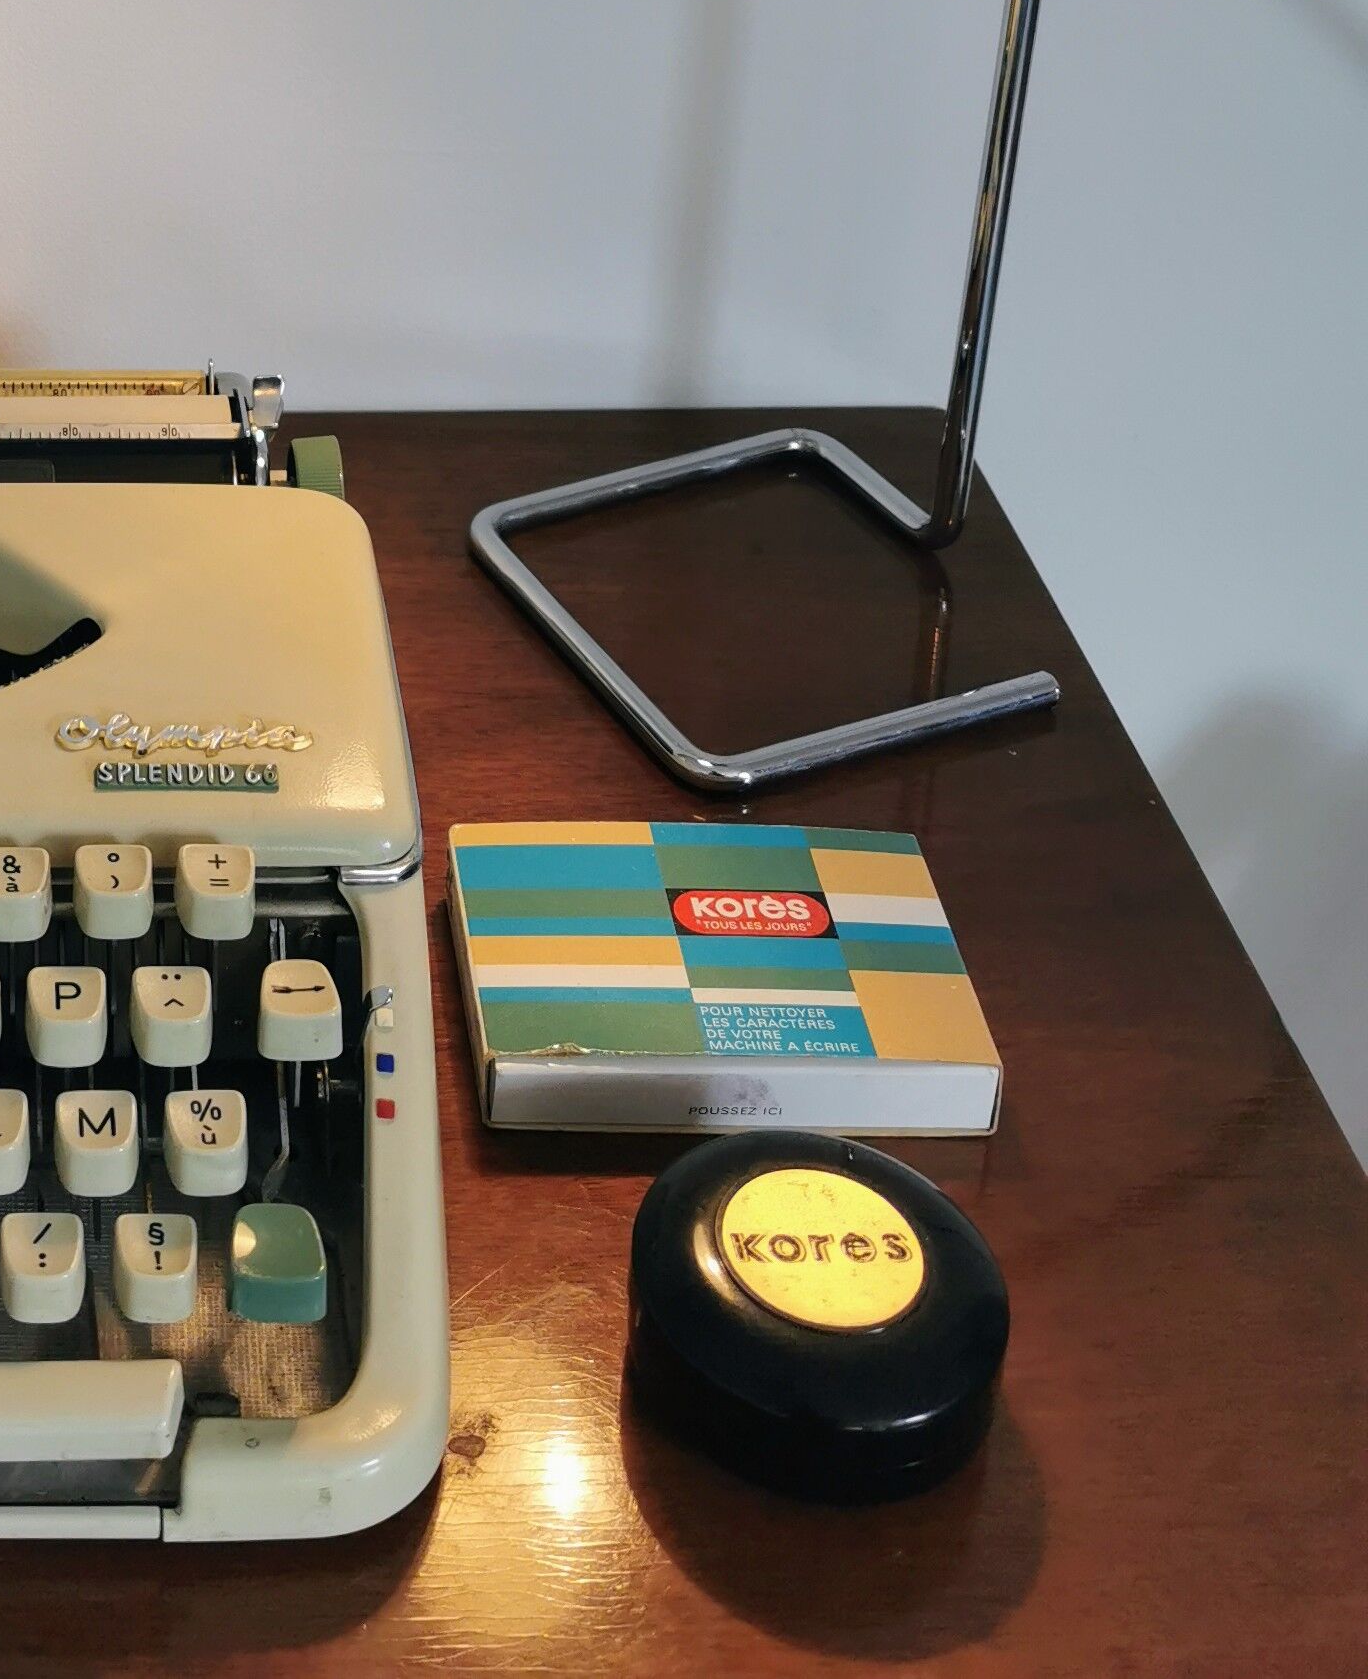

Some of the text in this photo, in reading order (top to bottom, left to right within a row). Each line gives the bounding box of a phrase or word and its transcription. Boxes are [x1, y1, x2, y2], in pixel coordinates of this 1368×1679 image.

[54, 712, 315, 759] Olympia
[96, 762, 278, 786] SPLENDID 66
[2, 854, 22, 874] &
[5, 876, 20, 893] à
[739, 921, 763, 931] LES
[54, 981, 82, 1010] P
[700, 1006, 828, 1019] POUR NETTOYER
[702, 1017, 837, 1031] LES CARACTÈRES
[706, 1028, 783, 1040] DE VOTRE
[709, 1039, 862, 1053] MACHINE A ÉCRIRE
[190, 1098, 222, 1123] %
[688, 1106, 783, 1116] POUSSEZ ICI
[78, 1106, 117, 1138] M
[201, 1124, 217, 1145] ù
[147, 1222, 165, 1246] §
[154, 1250, 163, 1271] !
